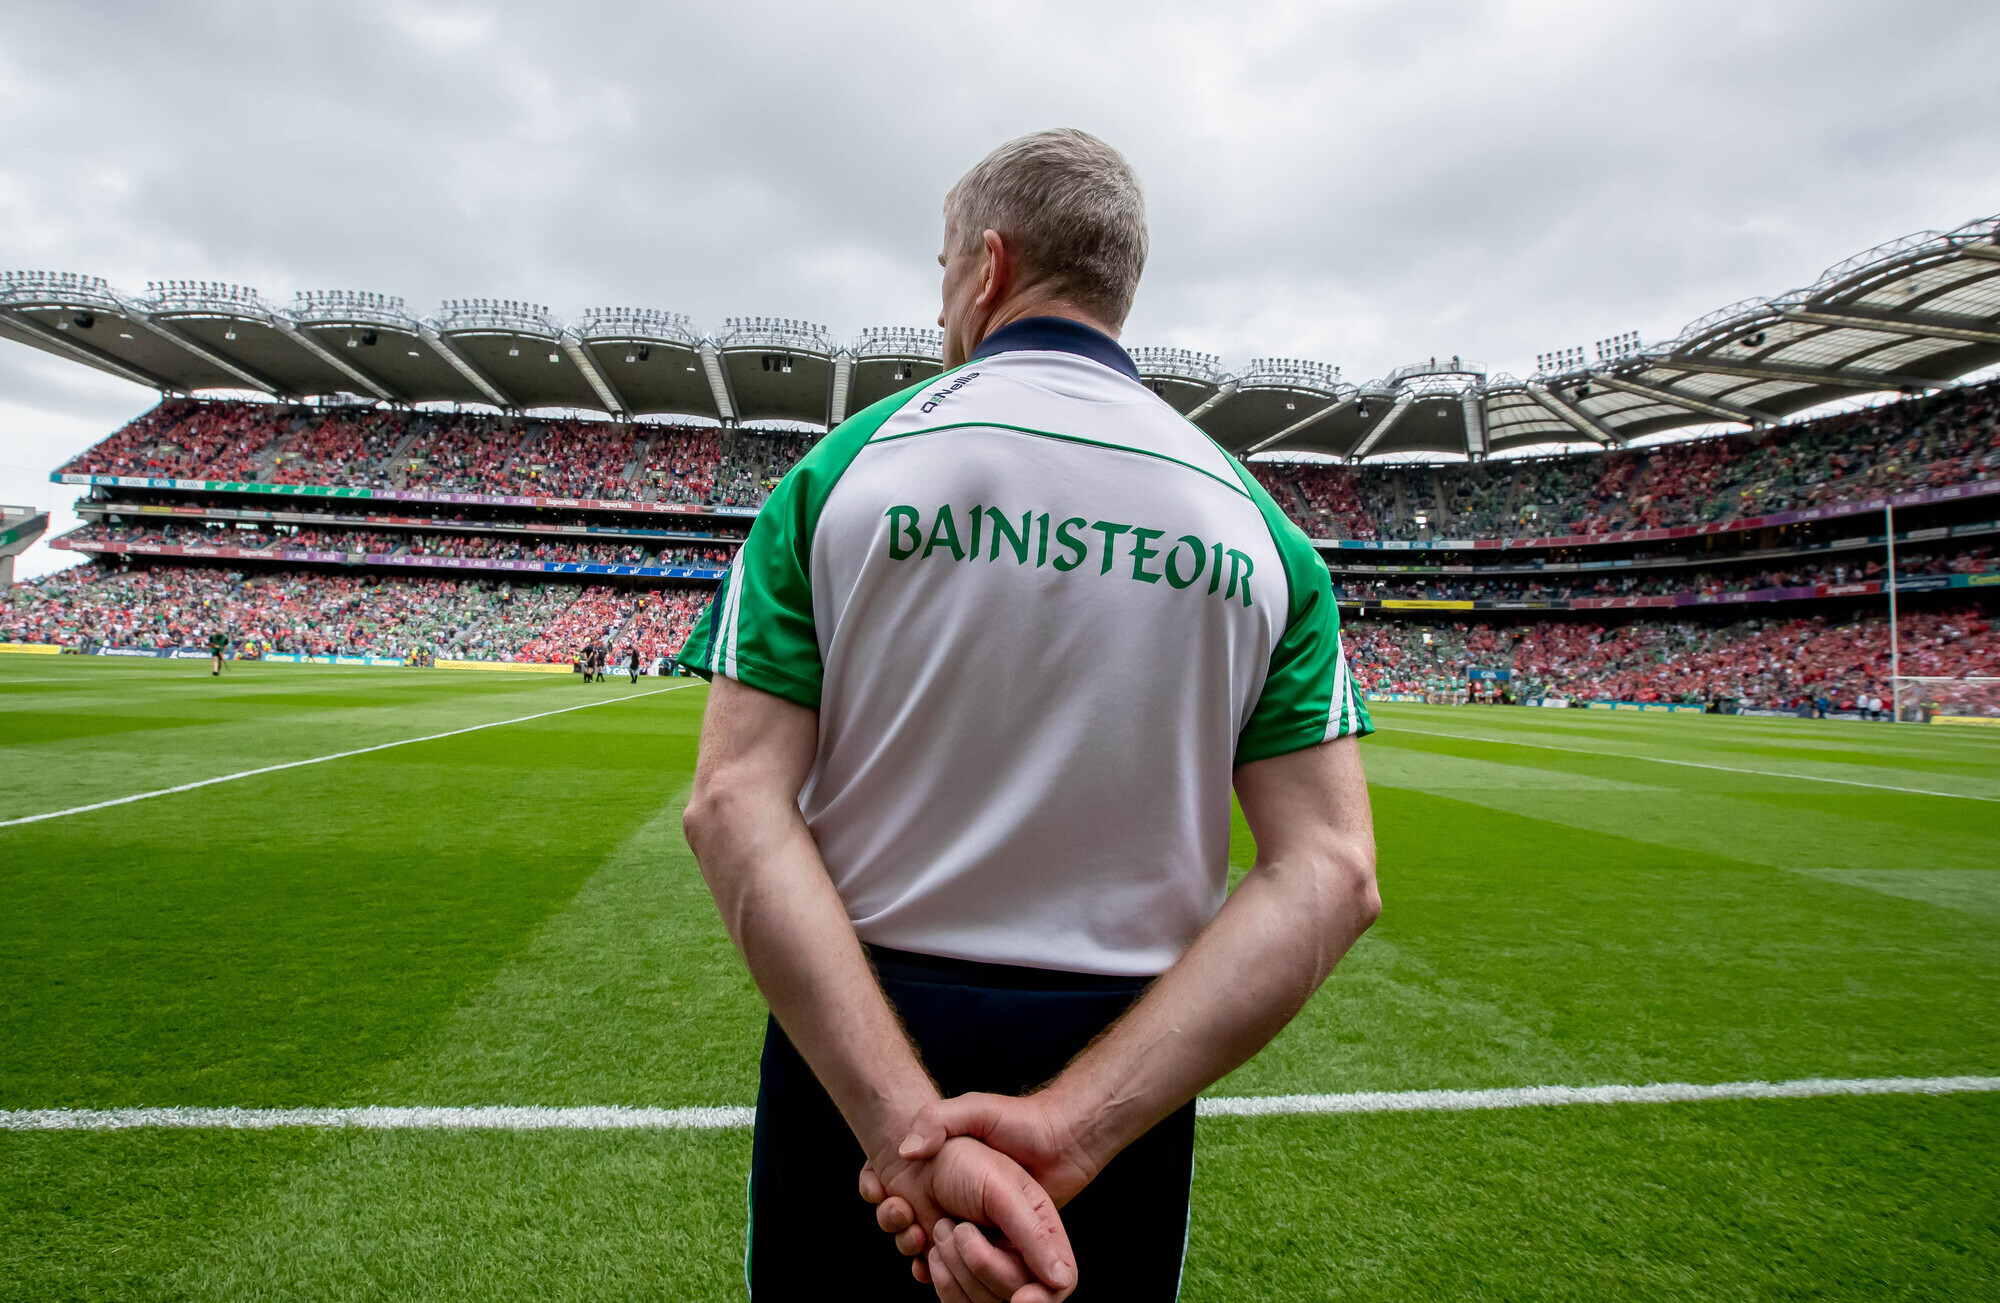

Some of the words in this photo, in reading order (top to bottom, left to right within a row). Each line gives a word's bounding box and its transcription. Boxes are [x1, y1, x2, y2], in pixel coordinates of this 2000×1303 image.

[519, 496, 532, 505] AIB
[546, 497, 579, 507] SuperValu
[599, 499, 632, 509] SuperValu
[653, 503, 686, 512] SuperValu
[884, 503, 1254, 608] BAINISTEOIR
[528, 562, 541, 570] AIB
